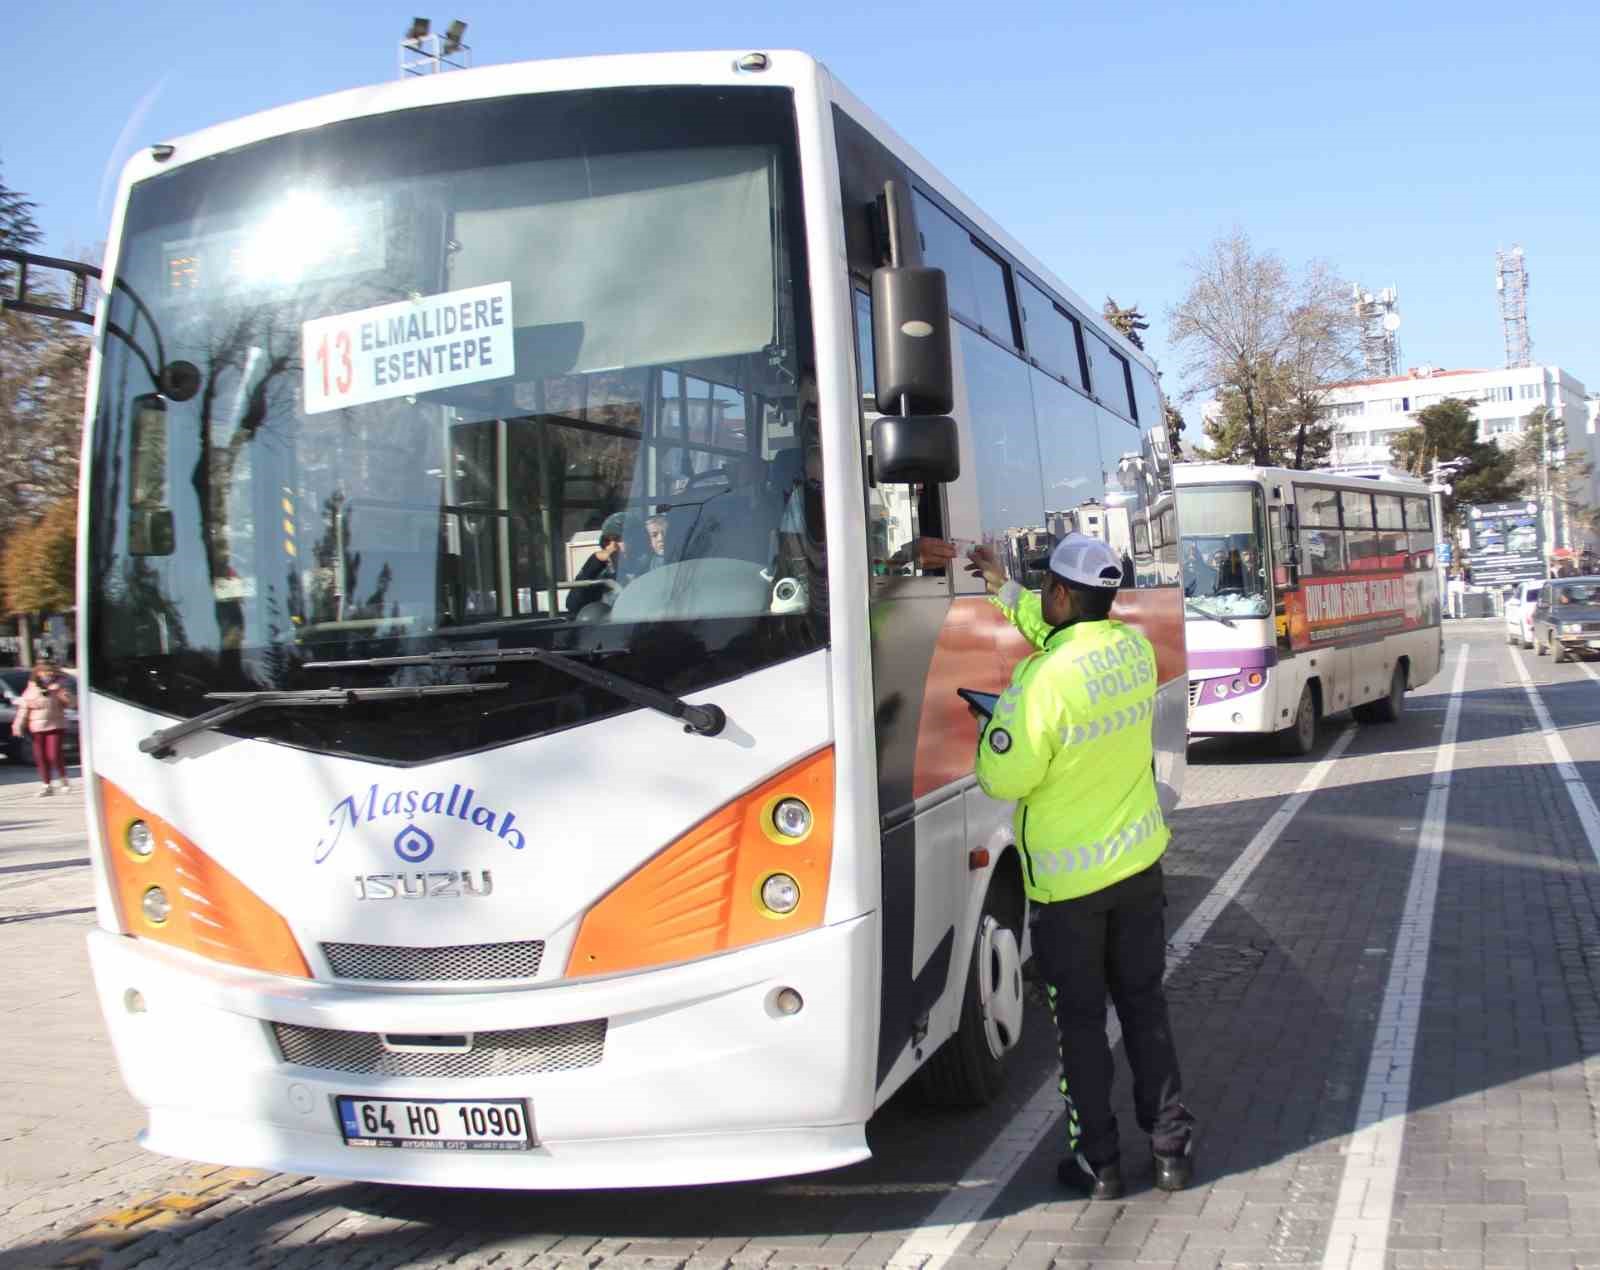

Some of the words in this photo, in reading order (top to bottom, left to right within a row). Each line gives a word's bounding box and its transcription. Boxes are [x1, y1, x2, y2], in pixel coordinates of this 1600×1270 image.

[361, 296, 504, 352] ELMALIDERE
[316, 331, 353, 396] 13
[373, 335, 493, 386] ESENTEPE
[315, 783, 526, 864] Maşallah
[355, 869, 493, 900] ISUZU
[362, 1104, 395, 1134] 64
[407, 1106, 440, 1136] HO
[459, 1107, 522, 1137] 1090
